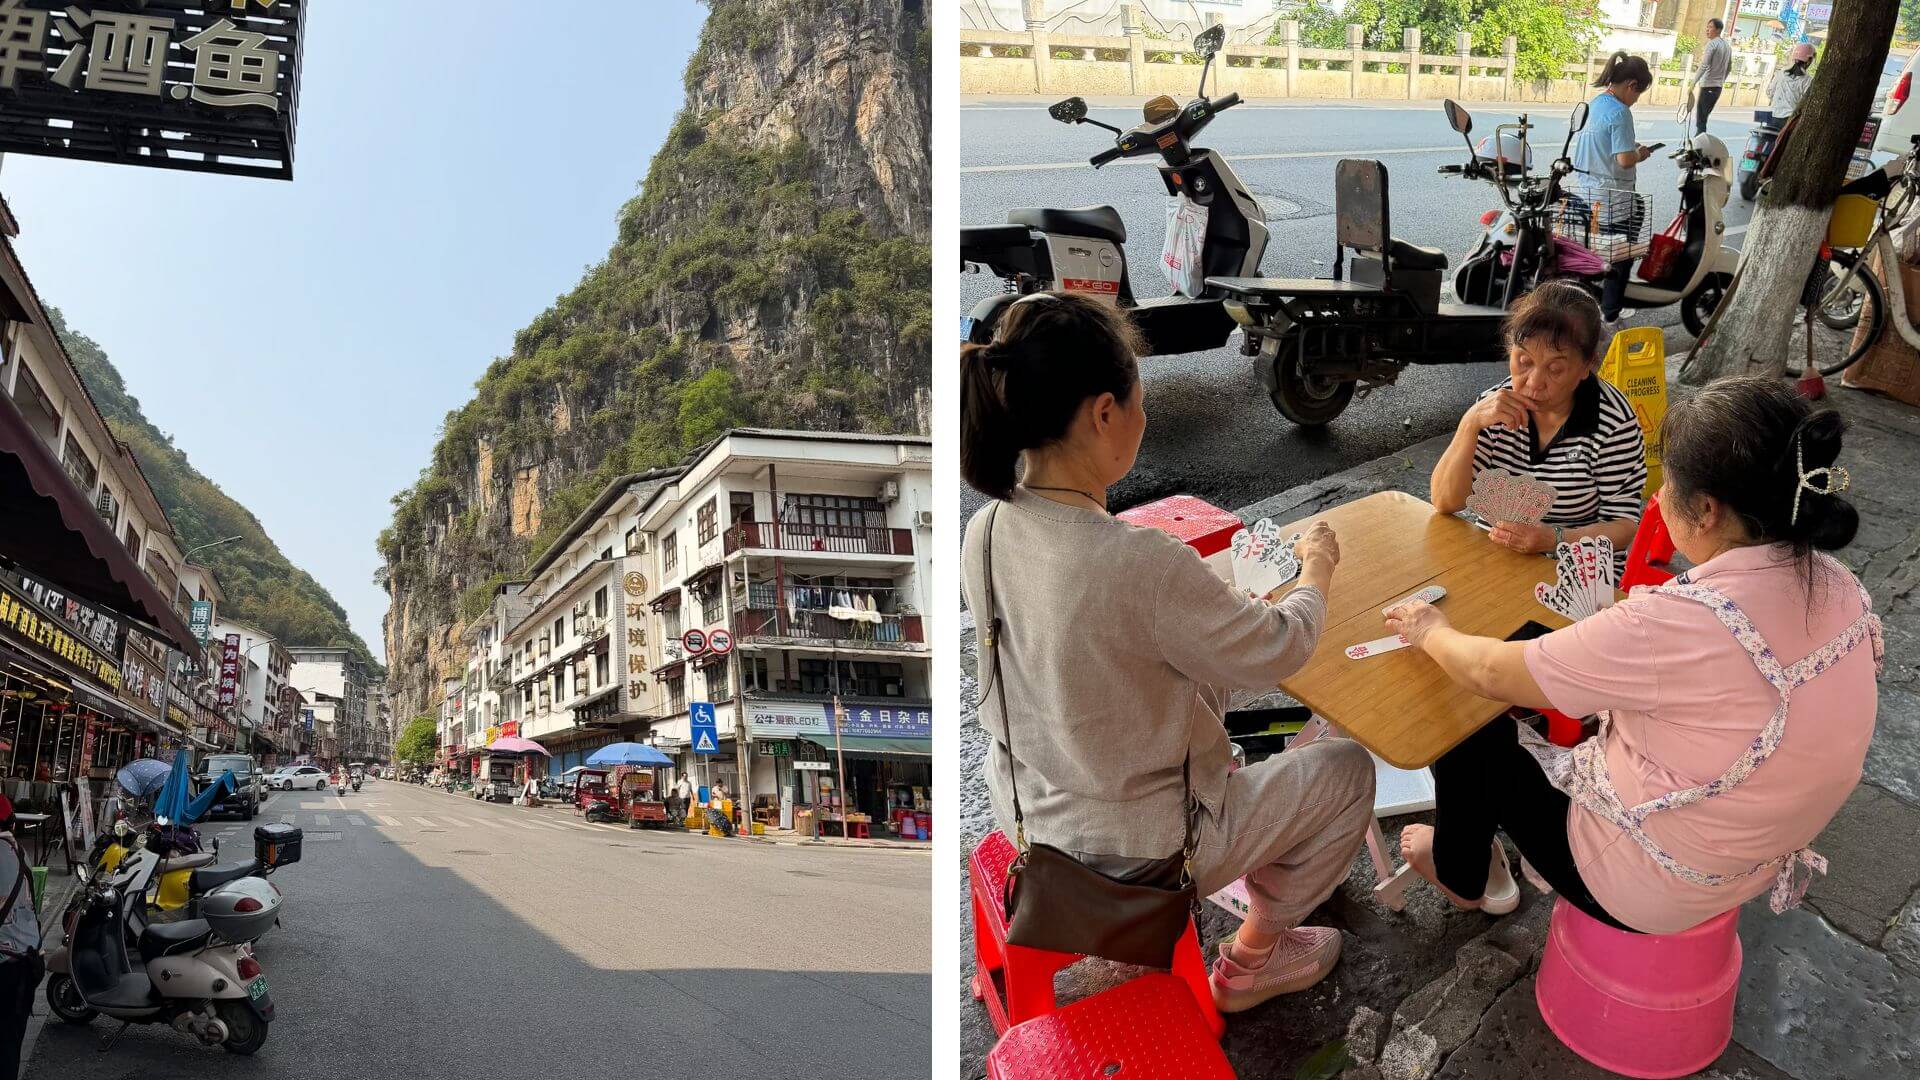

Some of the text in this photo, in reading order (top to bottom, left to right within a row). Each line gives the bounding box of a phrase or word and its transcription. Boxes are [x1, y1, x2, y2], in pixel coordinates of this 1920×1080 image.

[1626, 376, 1657, 389] CLEANING
[1630, 385, 1660, 398] PROGRESS
[190, 606, 209, 645] 博爱
[626, 603, 647, 700] 环境保护
